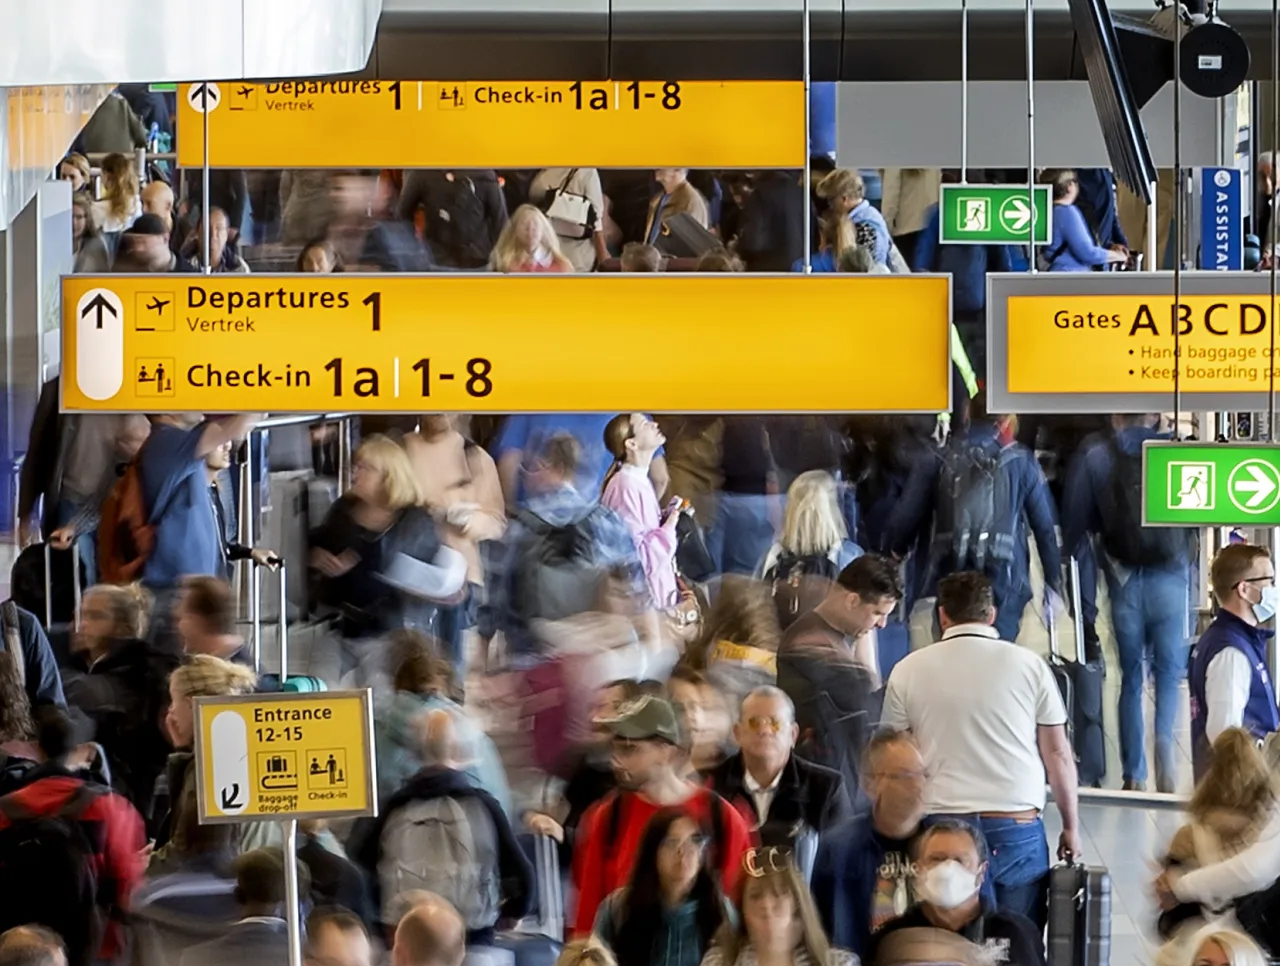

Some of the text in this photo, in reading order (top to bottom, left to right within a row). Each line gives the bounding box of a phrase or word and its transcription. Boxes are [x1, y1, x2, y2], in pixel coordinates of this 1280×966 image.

[387, 81, 401, 110] 1
[474, 86, 563, 104] Check-in
[569, 81, 608, 110] 1a
[265, 100, 315, 111] Vertrek
[187, 286, 382, 332] Departures 1
[187, 316, 256, 333] Vertrek
[1054, 310, 1121, 329] Gates
[1140, 345, 1182, 359] Hand
[1187, 344, 1257, 362] baggage
[187, 363, 311, 388] Check-in
[324, 357, 380, 397] 1a
[1140, 365, 1181, 382] Keep
[1186, 364, 1258, 382] boarding
[254, 707, 333, 723] Entrance
[256, 726, 303, 743] 12-15
[308, 791, 348, 801] Check-in
